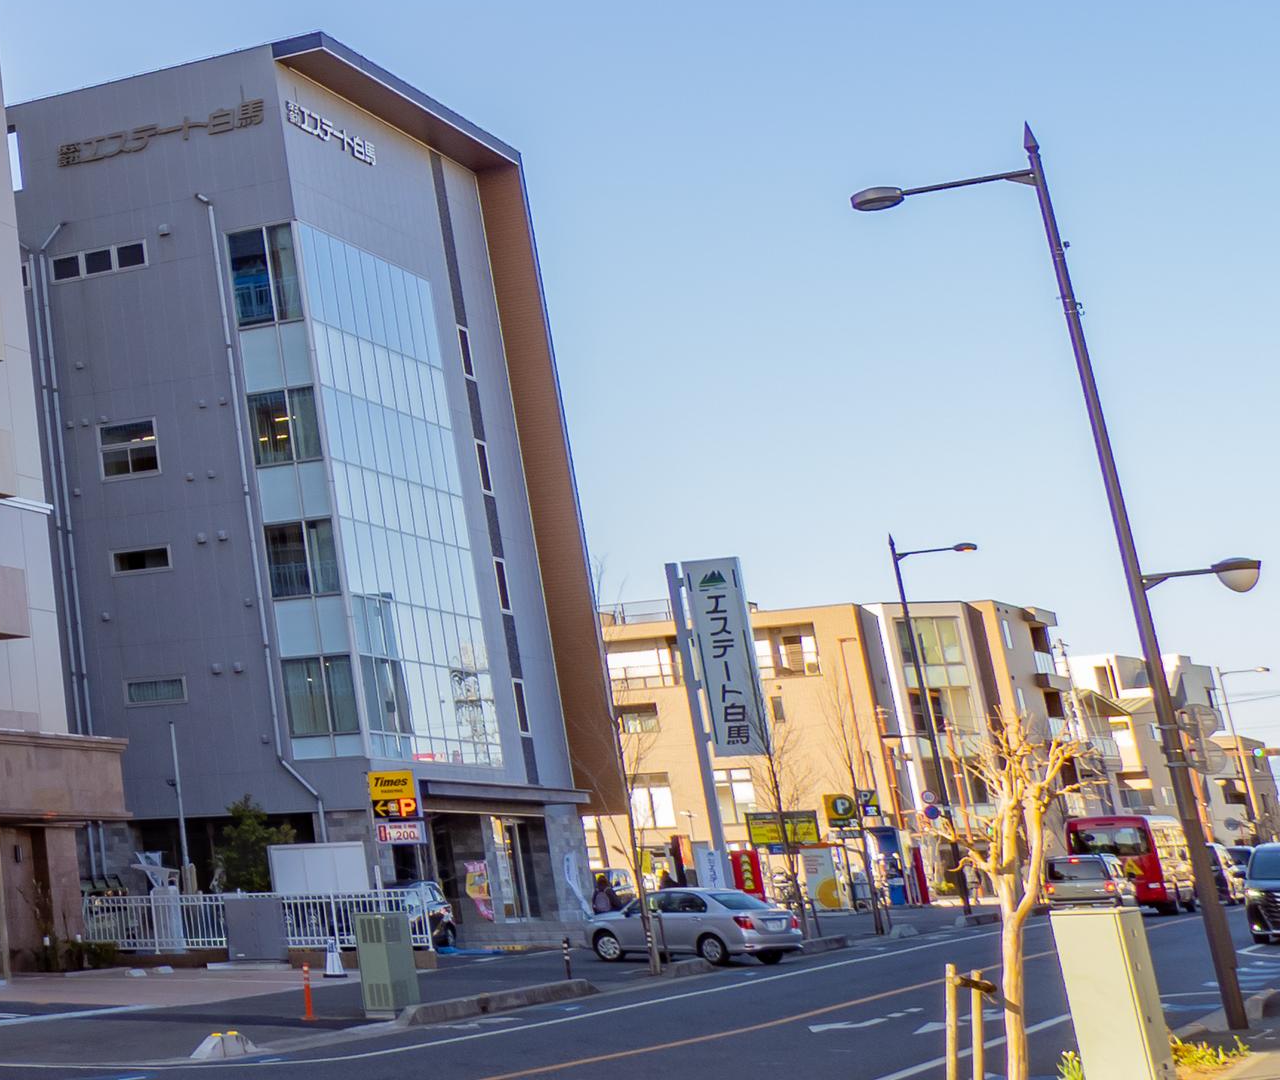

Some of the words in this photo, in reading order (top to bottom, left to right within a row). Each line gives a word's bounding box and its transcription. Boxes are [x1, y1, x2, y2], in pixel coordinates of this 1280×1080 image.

[705, 594, 751, 746] エステート白馬
[373, 777, 409, 788] Times
[400, 799, 417, 817] P
[835, 798, 850, 814] P
